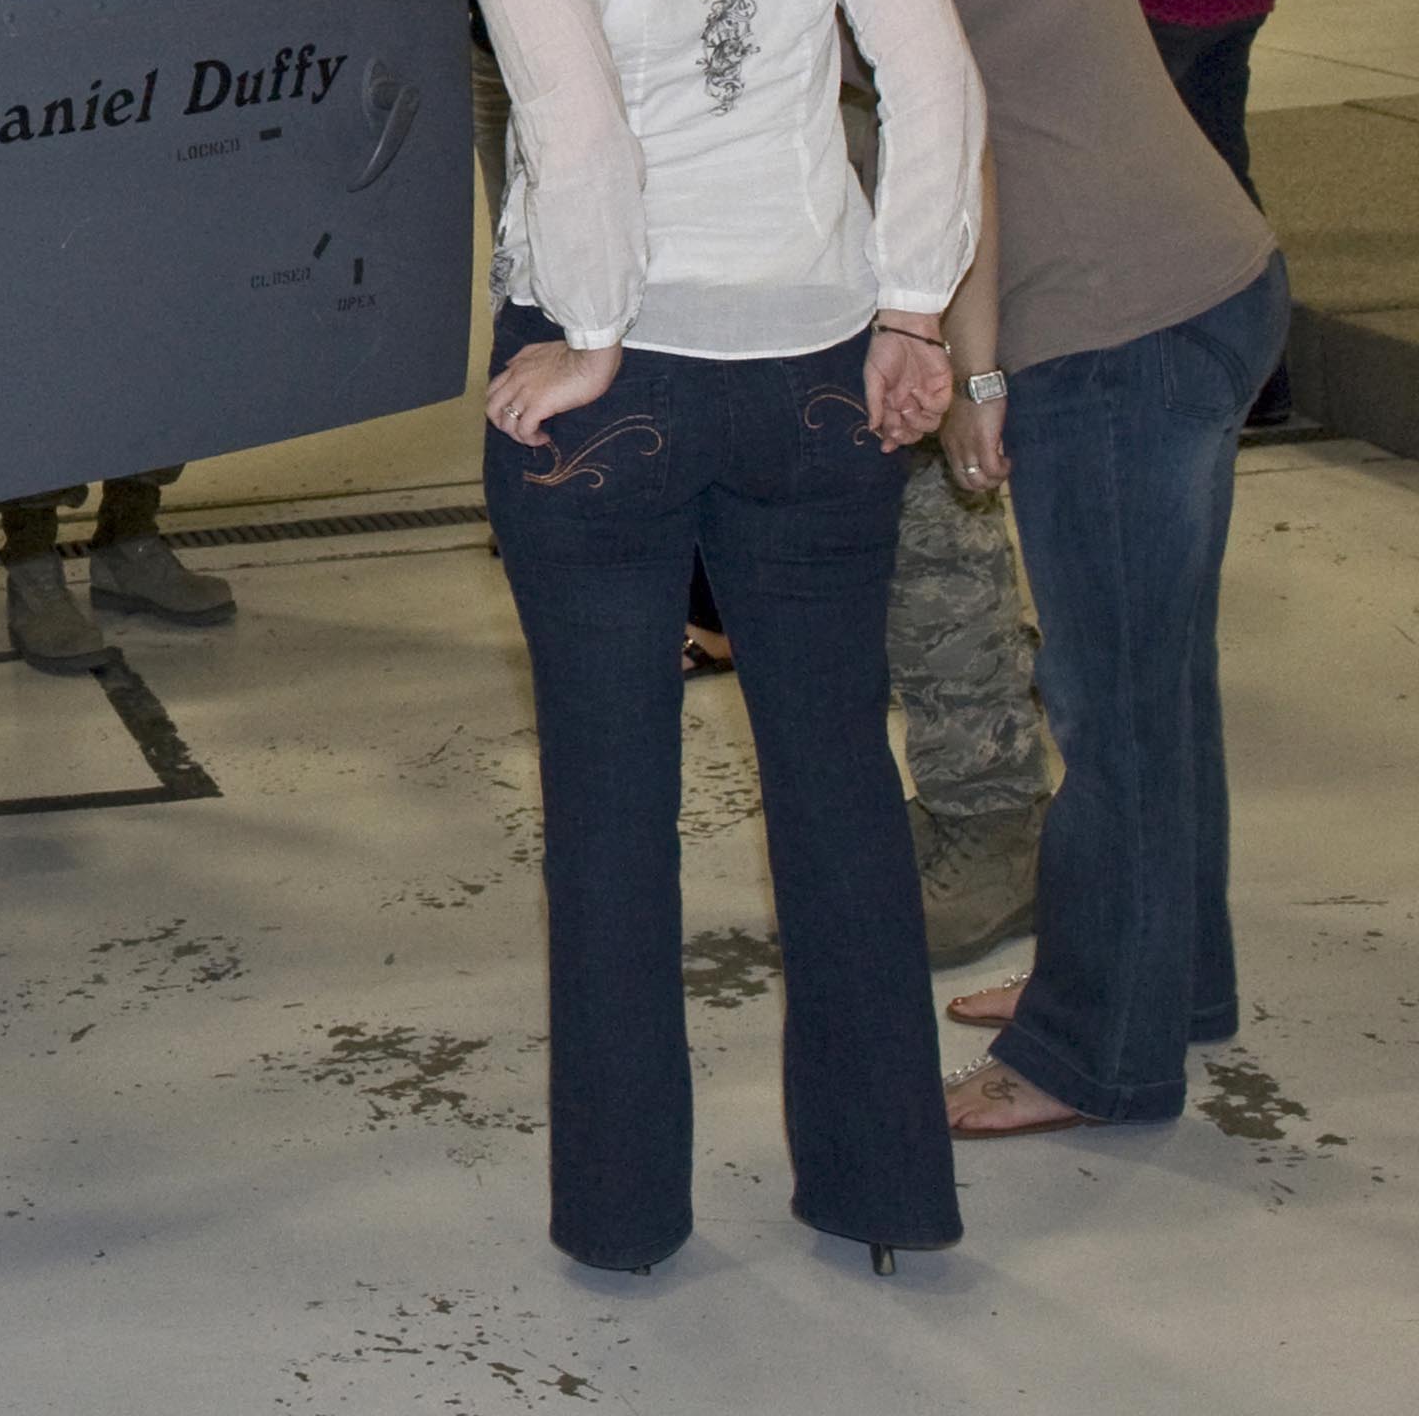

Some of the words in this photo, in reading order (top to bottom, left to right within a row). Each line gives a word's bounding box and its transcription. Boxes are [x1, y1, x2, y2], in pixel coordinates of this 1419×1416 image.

[183, 44, 349, 118] Duffy
[176, 137, 241, 162] LOCKED
[250, 266, 312, 289] CLOSED
[336, 293, 377, 312] OPEN
